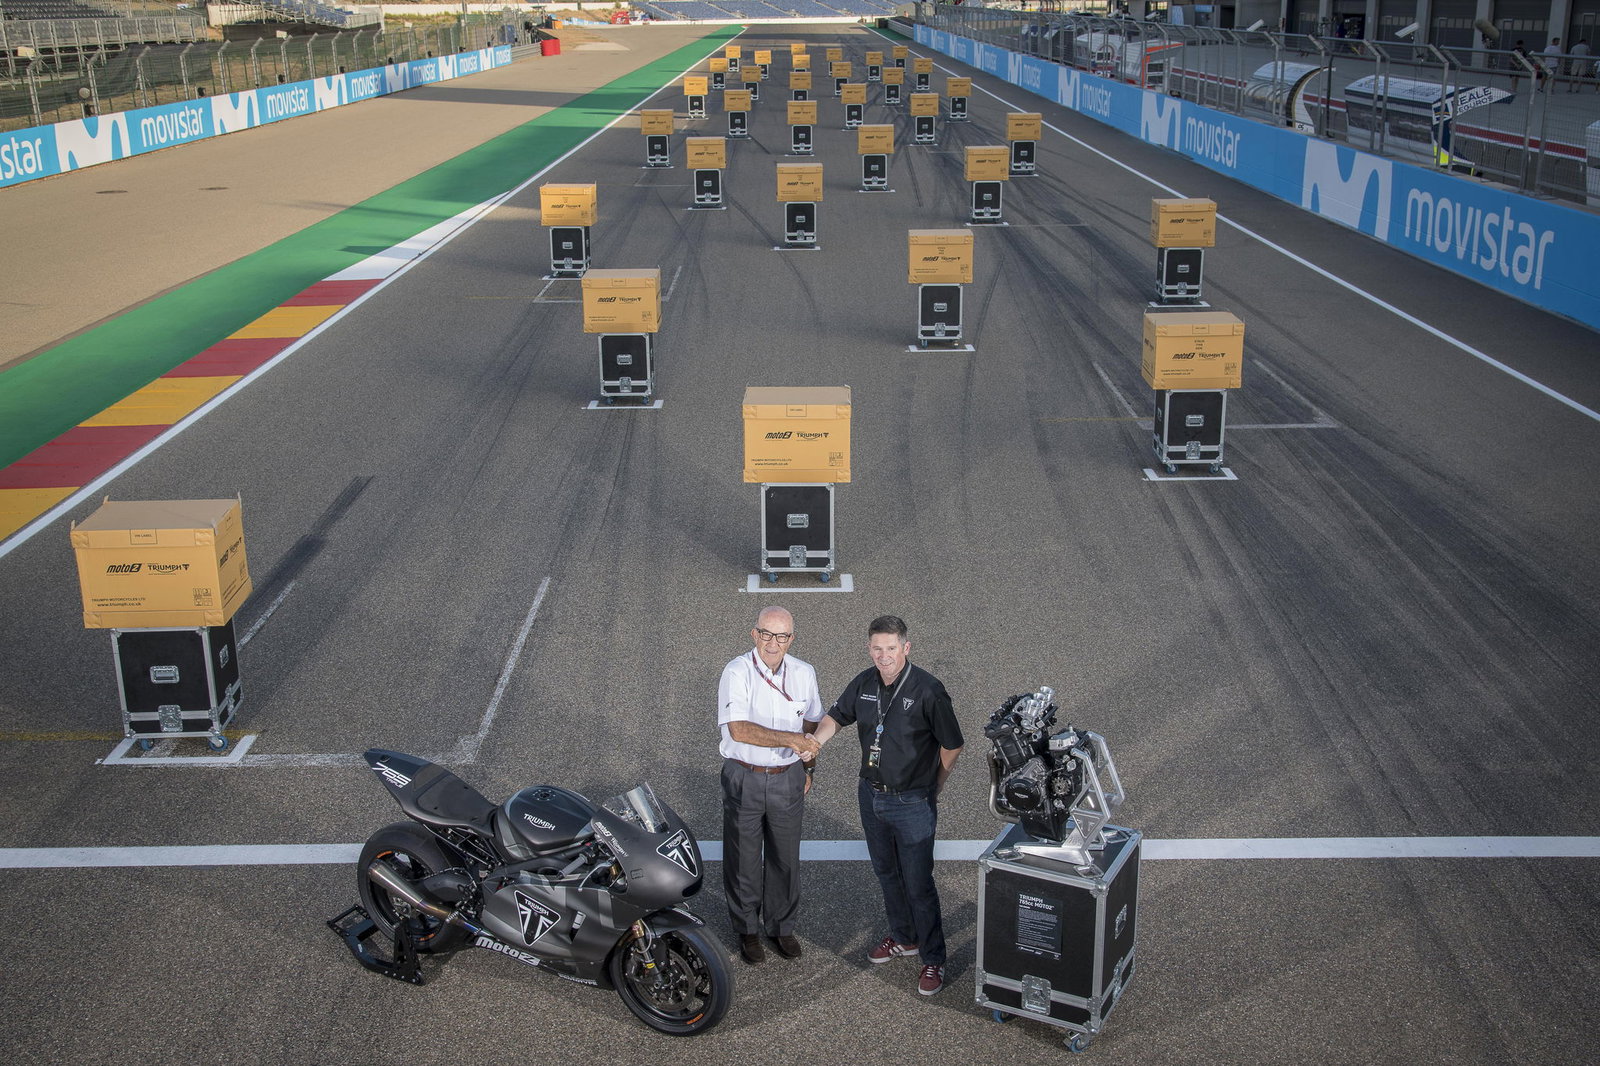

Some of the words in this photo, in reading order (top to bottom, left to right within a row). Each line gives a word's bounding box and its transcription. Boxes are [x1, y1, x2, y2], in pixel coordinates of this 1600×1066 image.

[412, 62, 436, 82] movistar
[460, 54, 478, 73] movistar
[1024, 63, 1042, 89] movistar
[351, 72, 382, 99] movistar
[1451, 87, 1493, 106] EALE
[267, 86, 309, 118] movistar
[1082, 83, 1112, 117] movistar
[1454, 94, 1494, 114] EGUROS
[141, 105, 204, 148] movistar
[1185, 115, 1241, 169] movistar
[0, 136, 42, 180] star
[1405, 188, 1555, 290] movistar
[765, 431, 793, 440] moto2
[796, 432, 823, 440] TRIUMPH
[107, 563, 143, 573] moto2
[147, 563, 182, 573] TRIUMPH
[371, 761, 412, 786] 765
[523, 813, 556, 831] TRIUMPH
[524, 898, 550, 916] TRIUMPH
[1019, 894, 1044, 903] TRIUMPH
[475, 936, 541, 966] moto2
